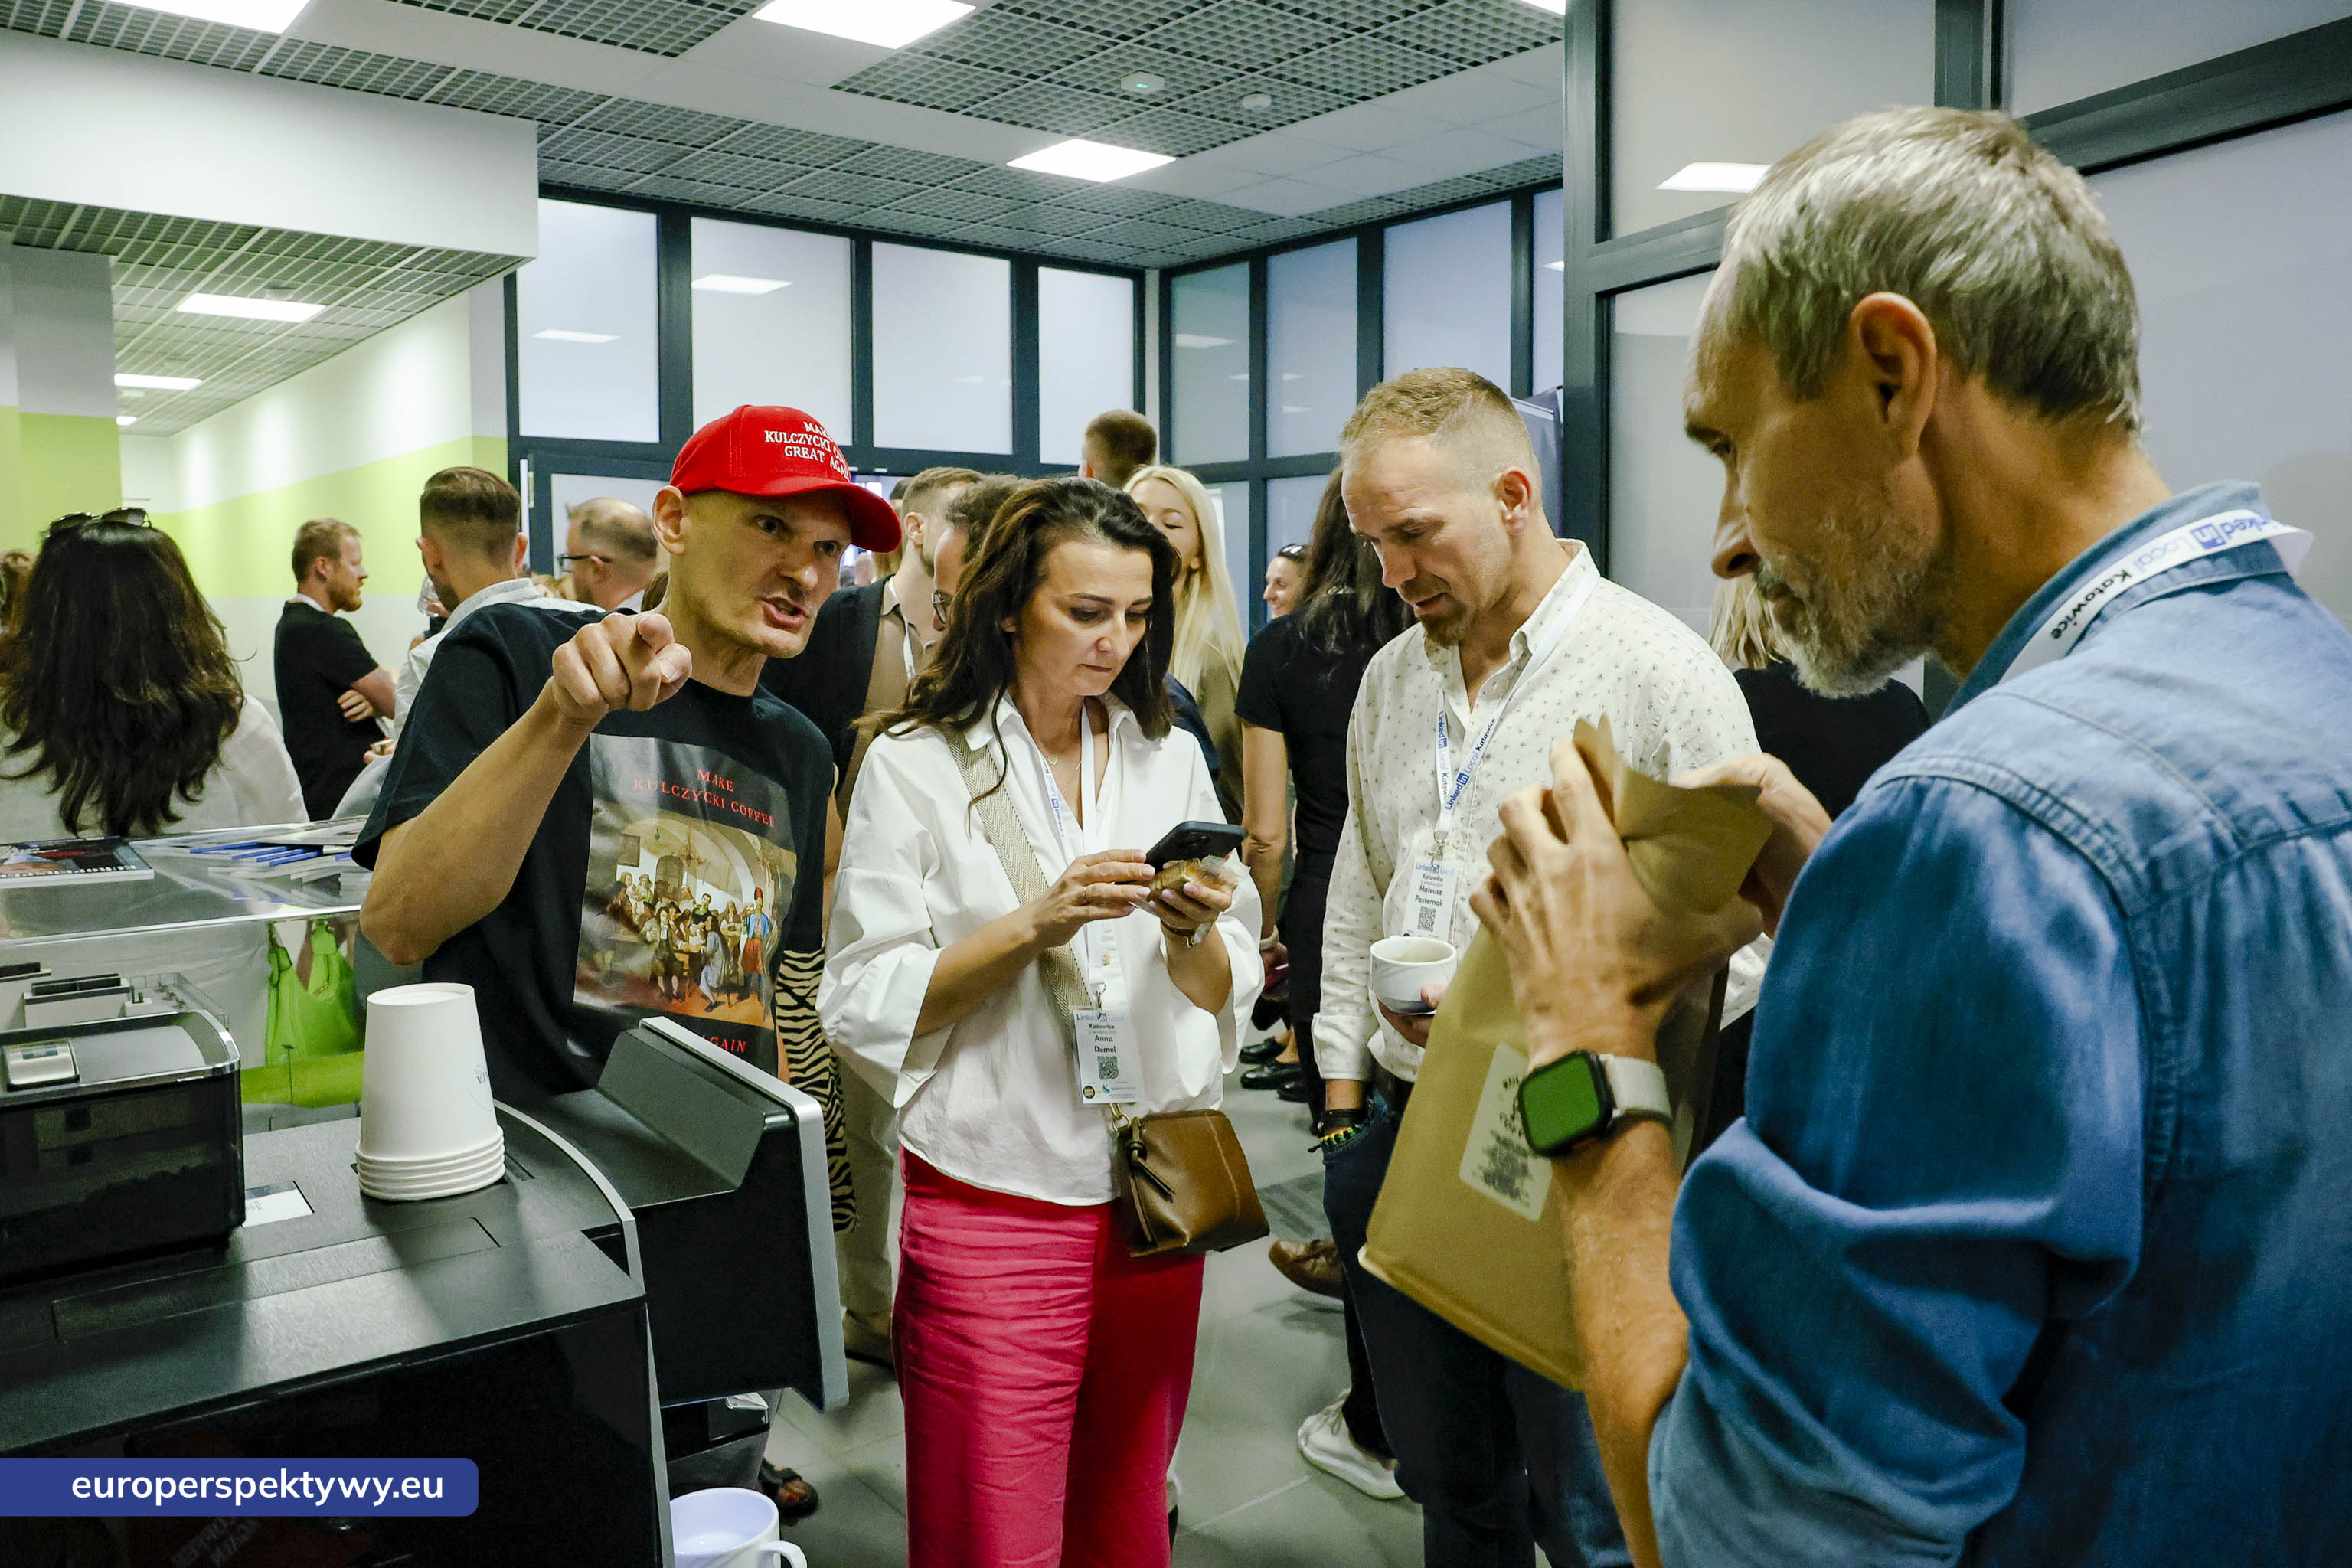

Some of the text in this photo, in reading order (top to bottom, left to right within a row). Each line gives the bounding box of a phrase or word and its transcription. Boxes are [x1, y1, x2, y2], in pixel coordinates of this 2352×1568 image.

[764, 430, 831, 452] KULCZYCKI
[784, 446, 825, 463] GREAT
[2132, 534, 2195, 573] Local
[2050, 569, 2132, 640] Katowice
[1463, 750, 1481, 774] Local
[1475, 718, 1495, 751] Katowice
[697, 769, 734, 792] MAKE
[633, 779, 775, 828] KULCZYCKI COFFEE
[1415, 894, 1443, 906] Pasternak
[1419, 885, 1442, 896] Mateusz
[1094, 1034, 1114, 1043] Anna
